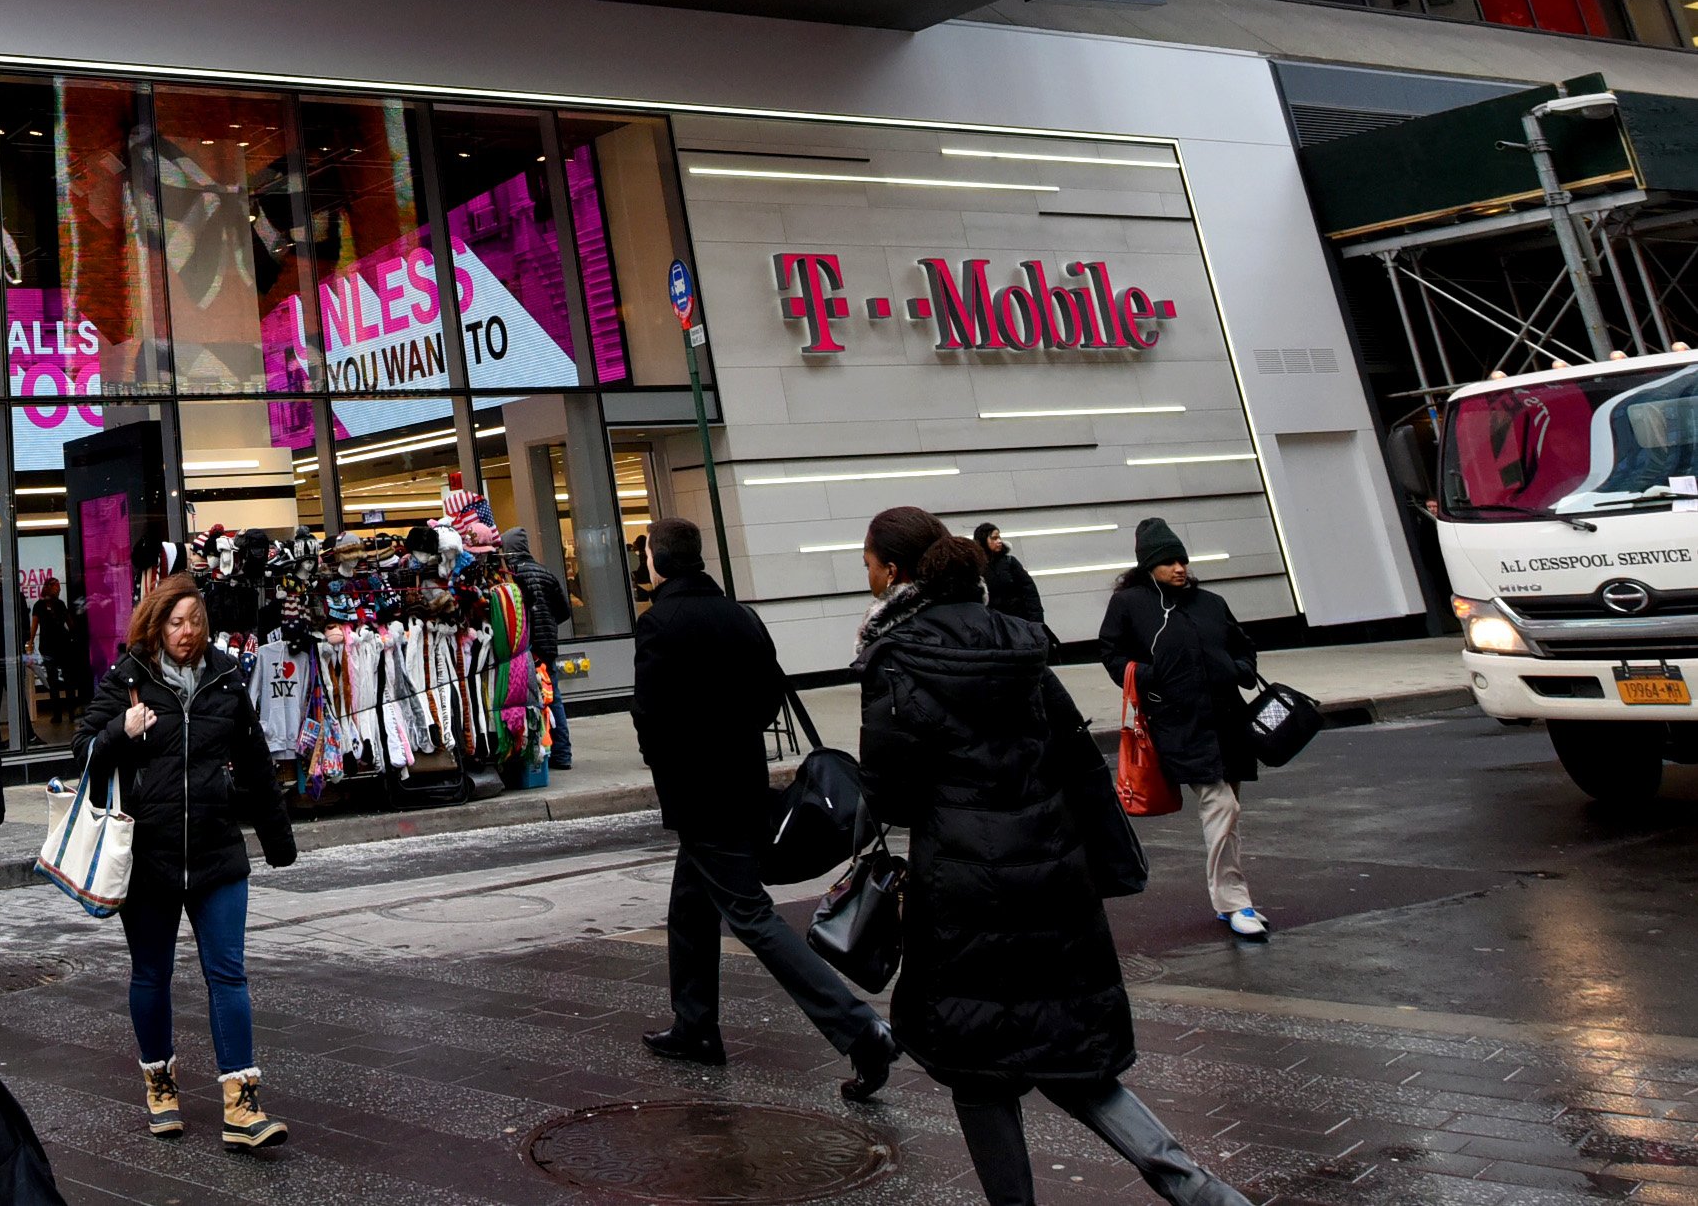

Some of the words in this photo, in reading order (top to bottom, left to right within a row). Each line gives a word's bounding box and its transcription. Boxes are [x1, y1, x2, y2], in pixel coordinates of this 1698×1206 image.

[327, 350, 378, 391] YOU
[381, 332, 445, 387] WAN
[465, 315, 508, 364] TO
[1529, 553, 1615, 572] CESSPOOL
[1617, 548, 1692, 566] SERVICE
[272, 662, 281, 679] I
[270, 680, 298, 699] NY
